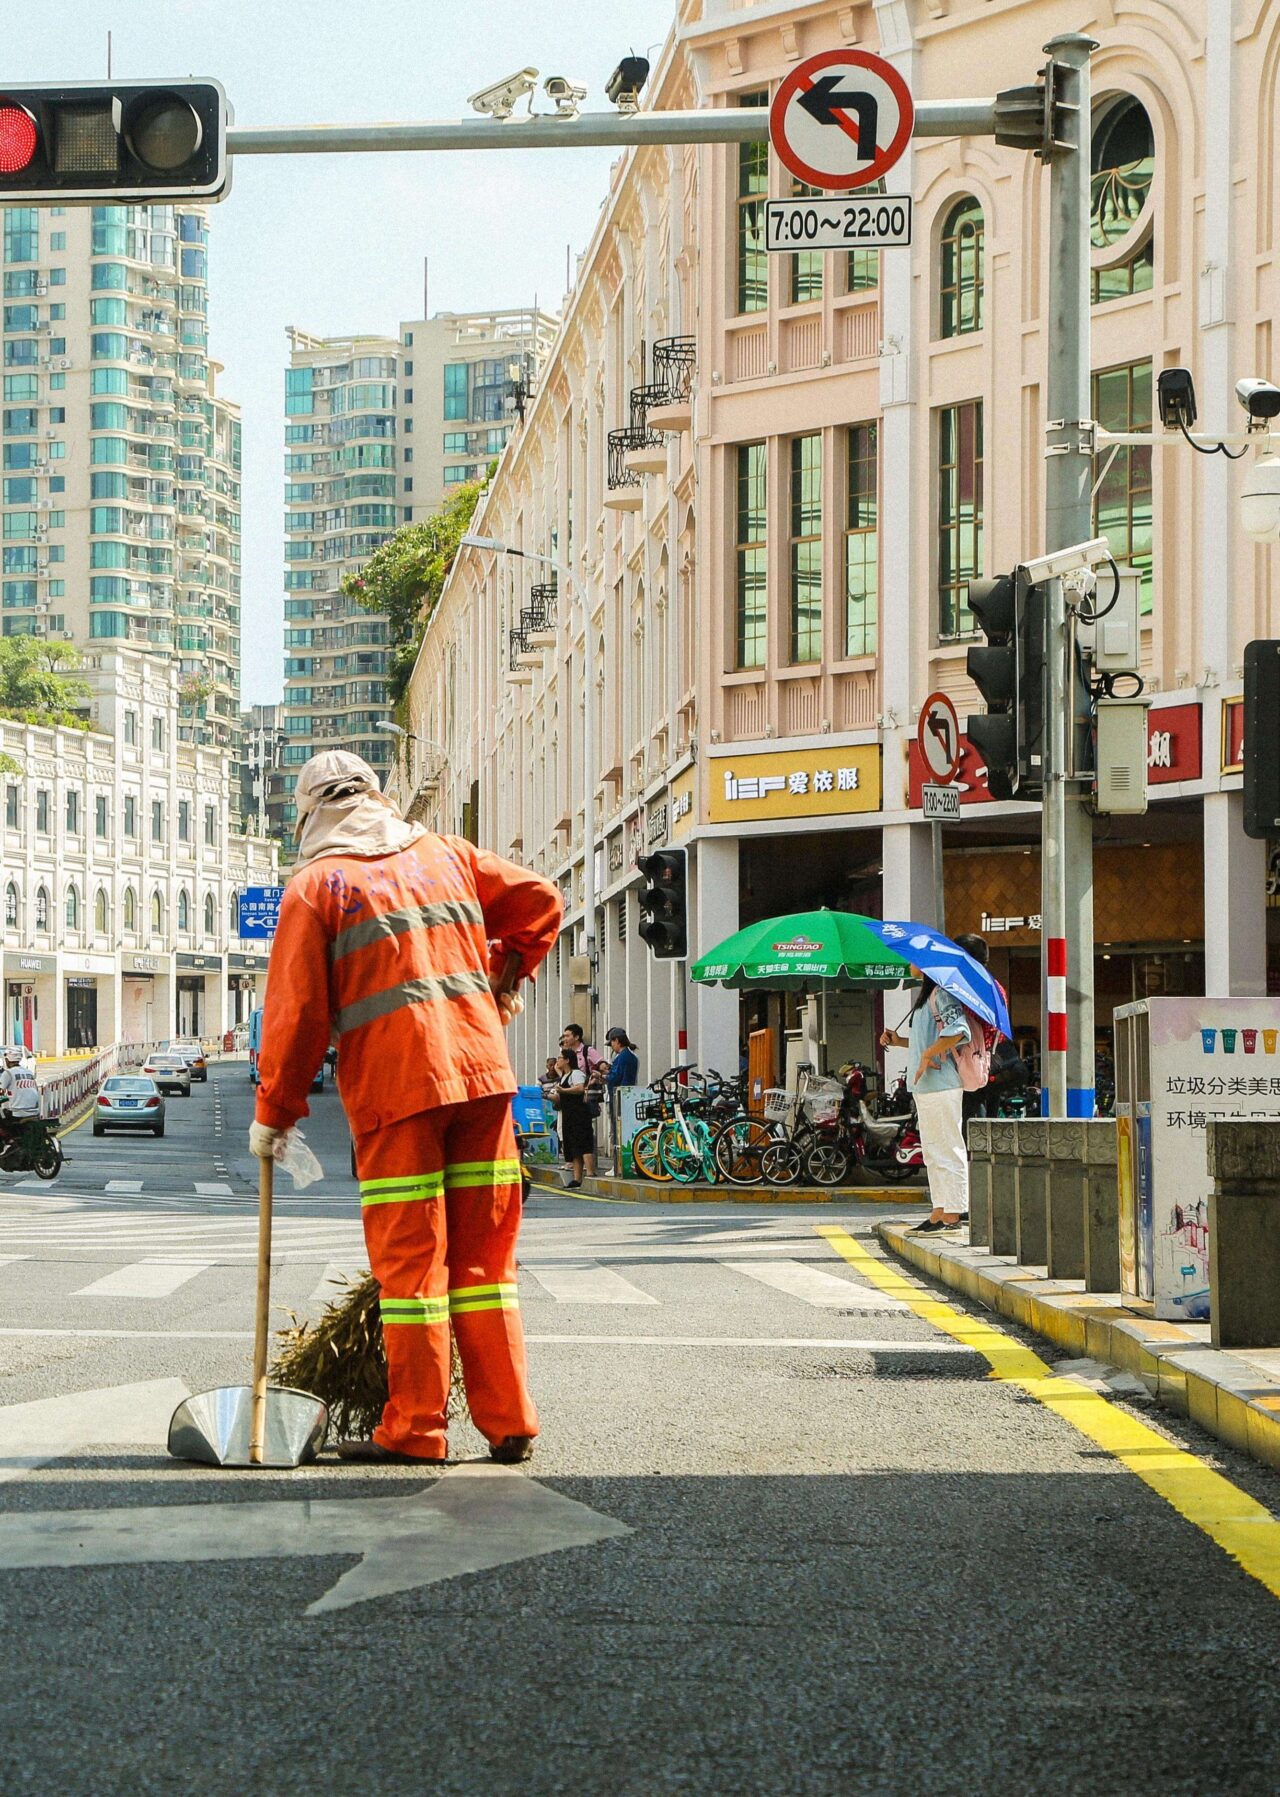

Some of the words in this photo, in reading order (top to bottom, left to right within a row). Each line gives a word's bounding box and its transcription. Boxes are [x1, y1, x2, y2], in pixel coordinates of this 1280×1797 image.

[770, 206, 905, 241] 7:00~22:00
[788, 767, 859, 795] 爱依服
[240, 902, 275, 911] 公园南路
[20, 957, 42, 970] HUAWEI
[794, 963, 827, 973] 文明出行
[864, 964, 905, 977] 青岛啤酒
